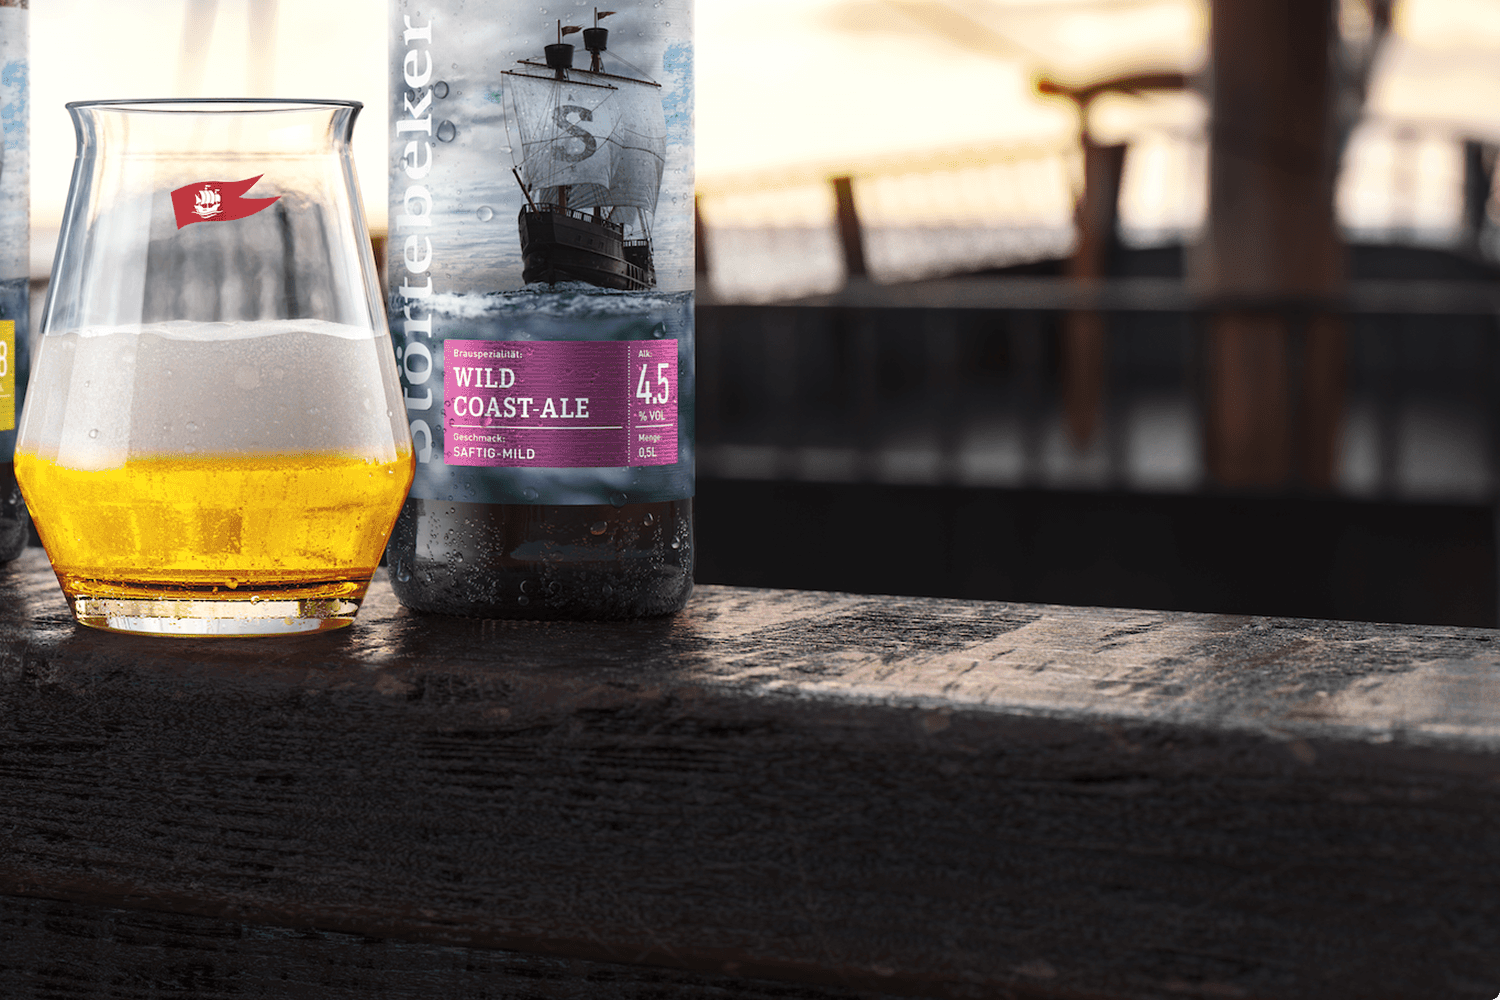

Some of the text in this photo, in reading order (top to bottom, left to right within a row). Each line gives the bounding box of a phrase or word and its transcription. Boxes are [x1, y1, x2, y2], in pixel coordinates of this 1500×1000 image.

[453, 349, 523, 359] Brauspezialität:
[453, 367, 515, 388] WILD
[636, 363, 669, 405] 4.5
[453, 396, 590, 418] COAST-ALE
[638, 410, 666, 421] % VOL
[453, 433, 506, 443] Geschmack:
[453, 446, 535, 460] SAFTIG-MILD
[638, 446, 657, 458] 0,5L
